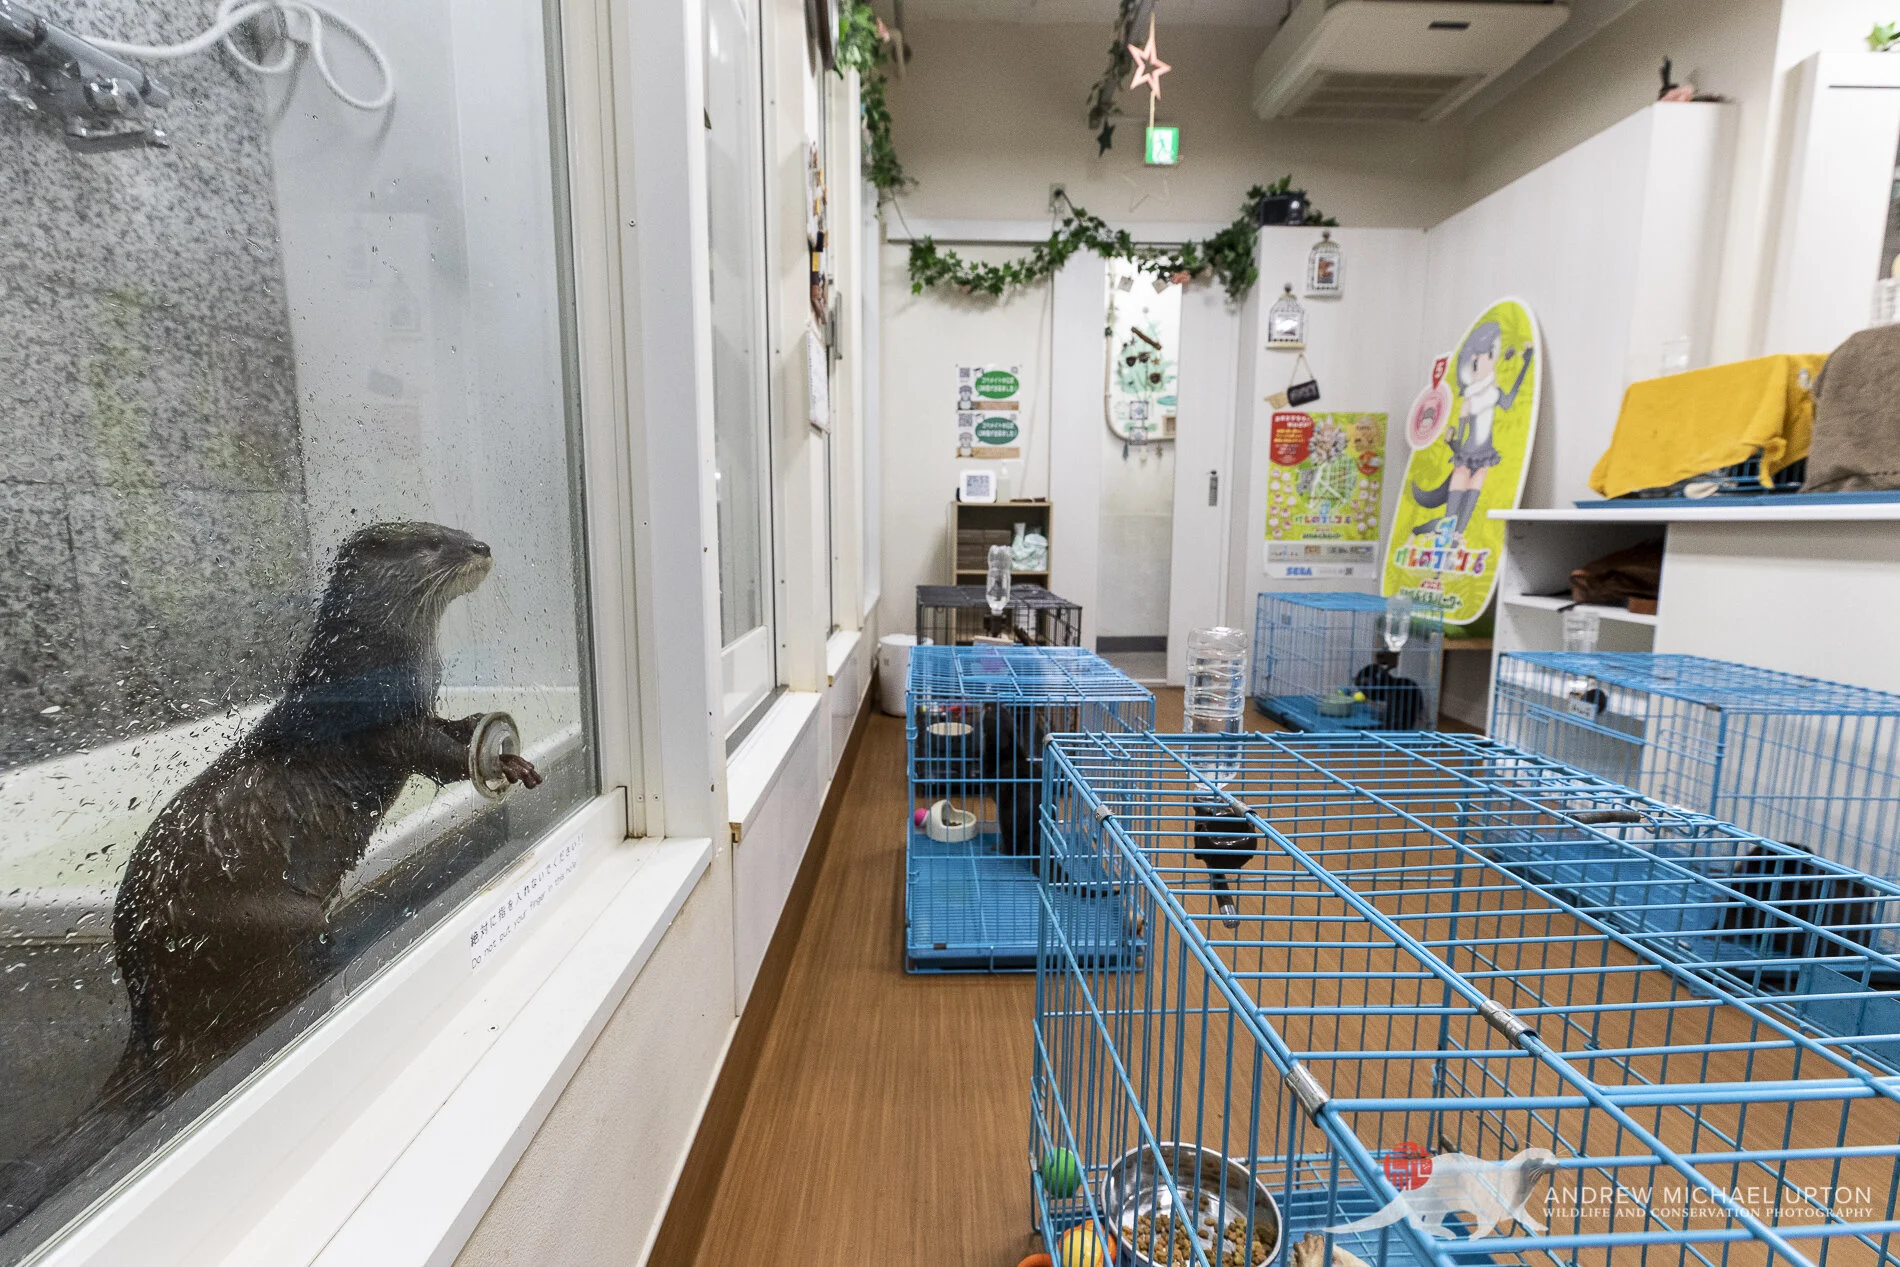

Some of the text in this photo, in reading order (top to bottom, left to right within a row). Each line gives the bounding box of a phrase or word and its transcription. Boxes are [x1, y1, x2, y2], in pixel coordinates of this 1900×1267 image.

[1286, 567, 1313, 576] SEGA
[471, 955, 481, 970] Do
[484, 940, 497, 957] not
